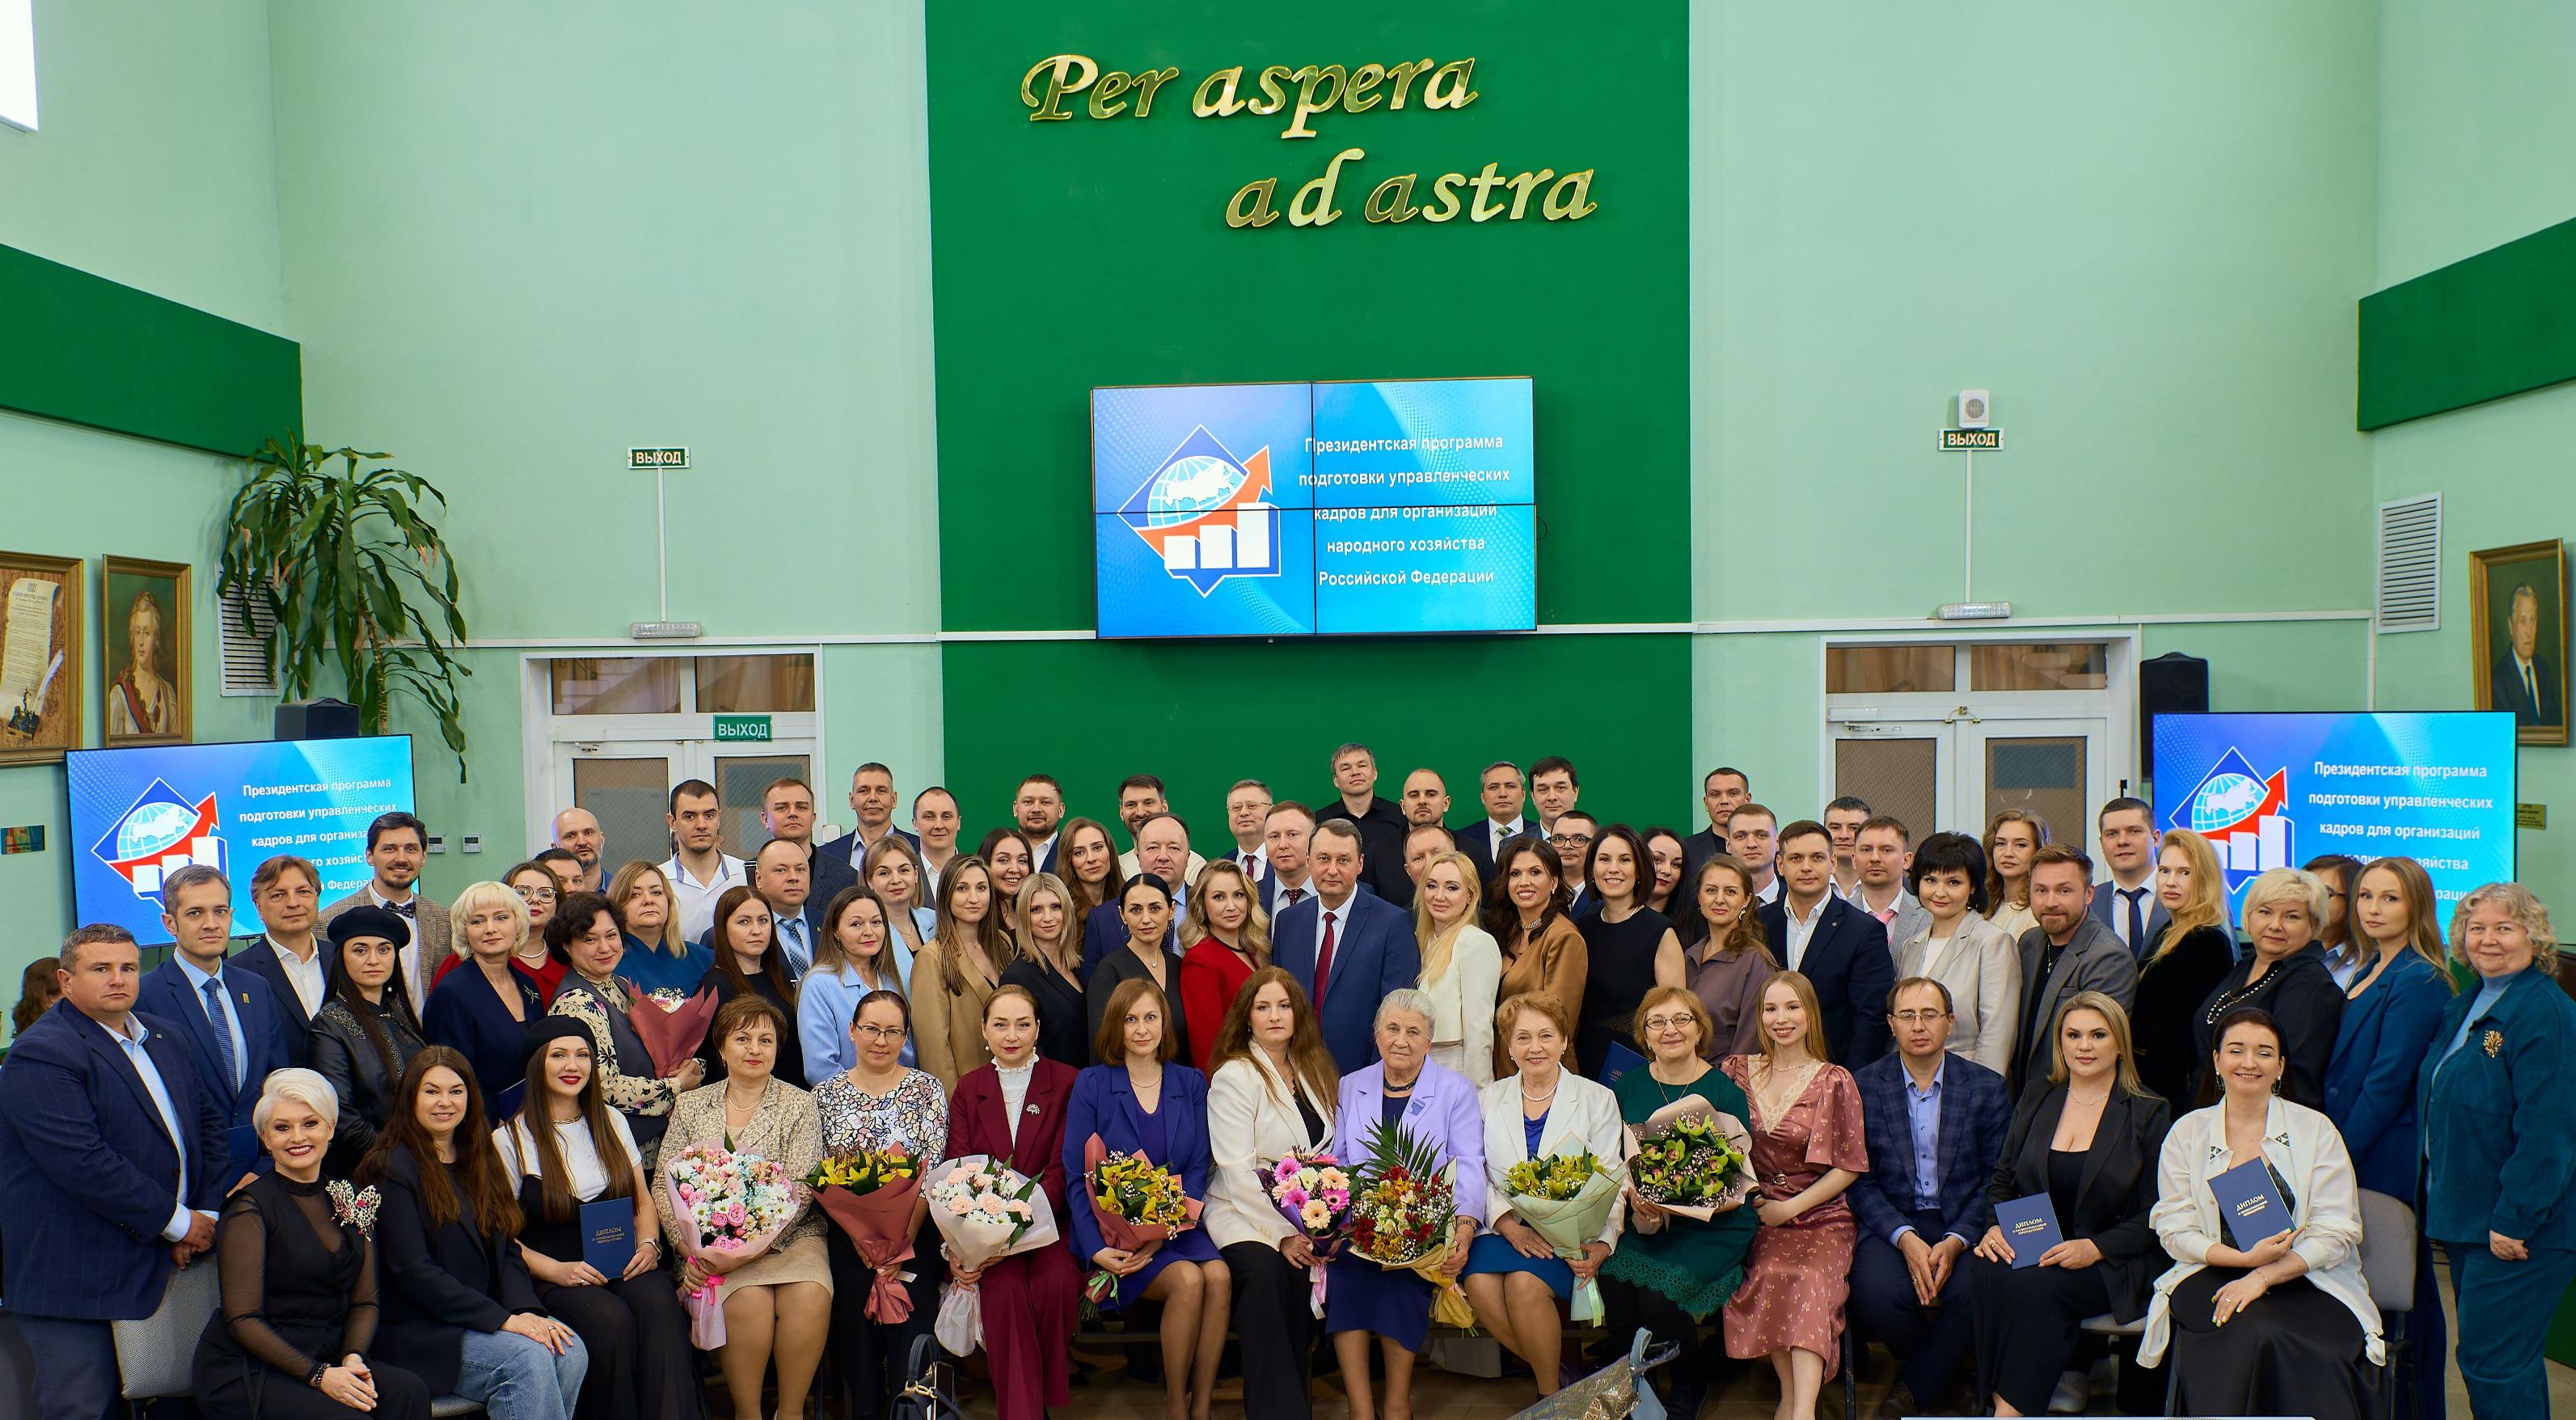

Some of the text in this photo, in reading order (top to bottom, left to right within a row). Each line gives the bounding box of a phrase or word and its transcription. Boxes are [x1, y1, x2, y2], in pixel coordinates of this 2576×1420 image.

[1021, 54, 1478, 139] Per aspera
[1227, 148, 1597, 228] ad astra
[1304, 437, 1503, 455] Президентская программа
[1948, 433, 1995, 446] ВЫХОД
[636, 451, 682, 464] ВЫХОД
[1299, 469, 1510, 487] подготовки управленческих
[1315, 501, 1497, 522] кадров для организаций
[1327, 536, 1485, 556] народного хозяйства
[1319, 569, 1494, 586] Российской Федерации
[718, 723, 767, 738] ВЫХОД
[2314, 762, 2487, 780] Президентская программа
[243, 779, 391, 798] Президентская программа
[2308, 793, 2493, 809] подготовки управленческих
[239, 803, 397, 823] подготовки управленческих
[251, 835, 293, 848] кадров
[295, 832, 317, 845] для
[2320, 823, 2480, 840] кадров для организаций
[2236, 1194, 2264, 1211] ДИПЛОМ
[595, 1226, 622, 1237] ДИПЛОМ
[2015, 1218, 2042, 1229] ДИПЛОМ
